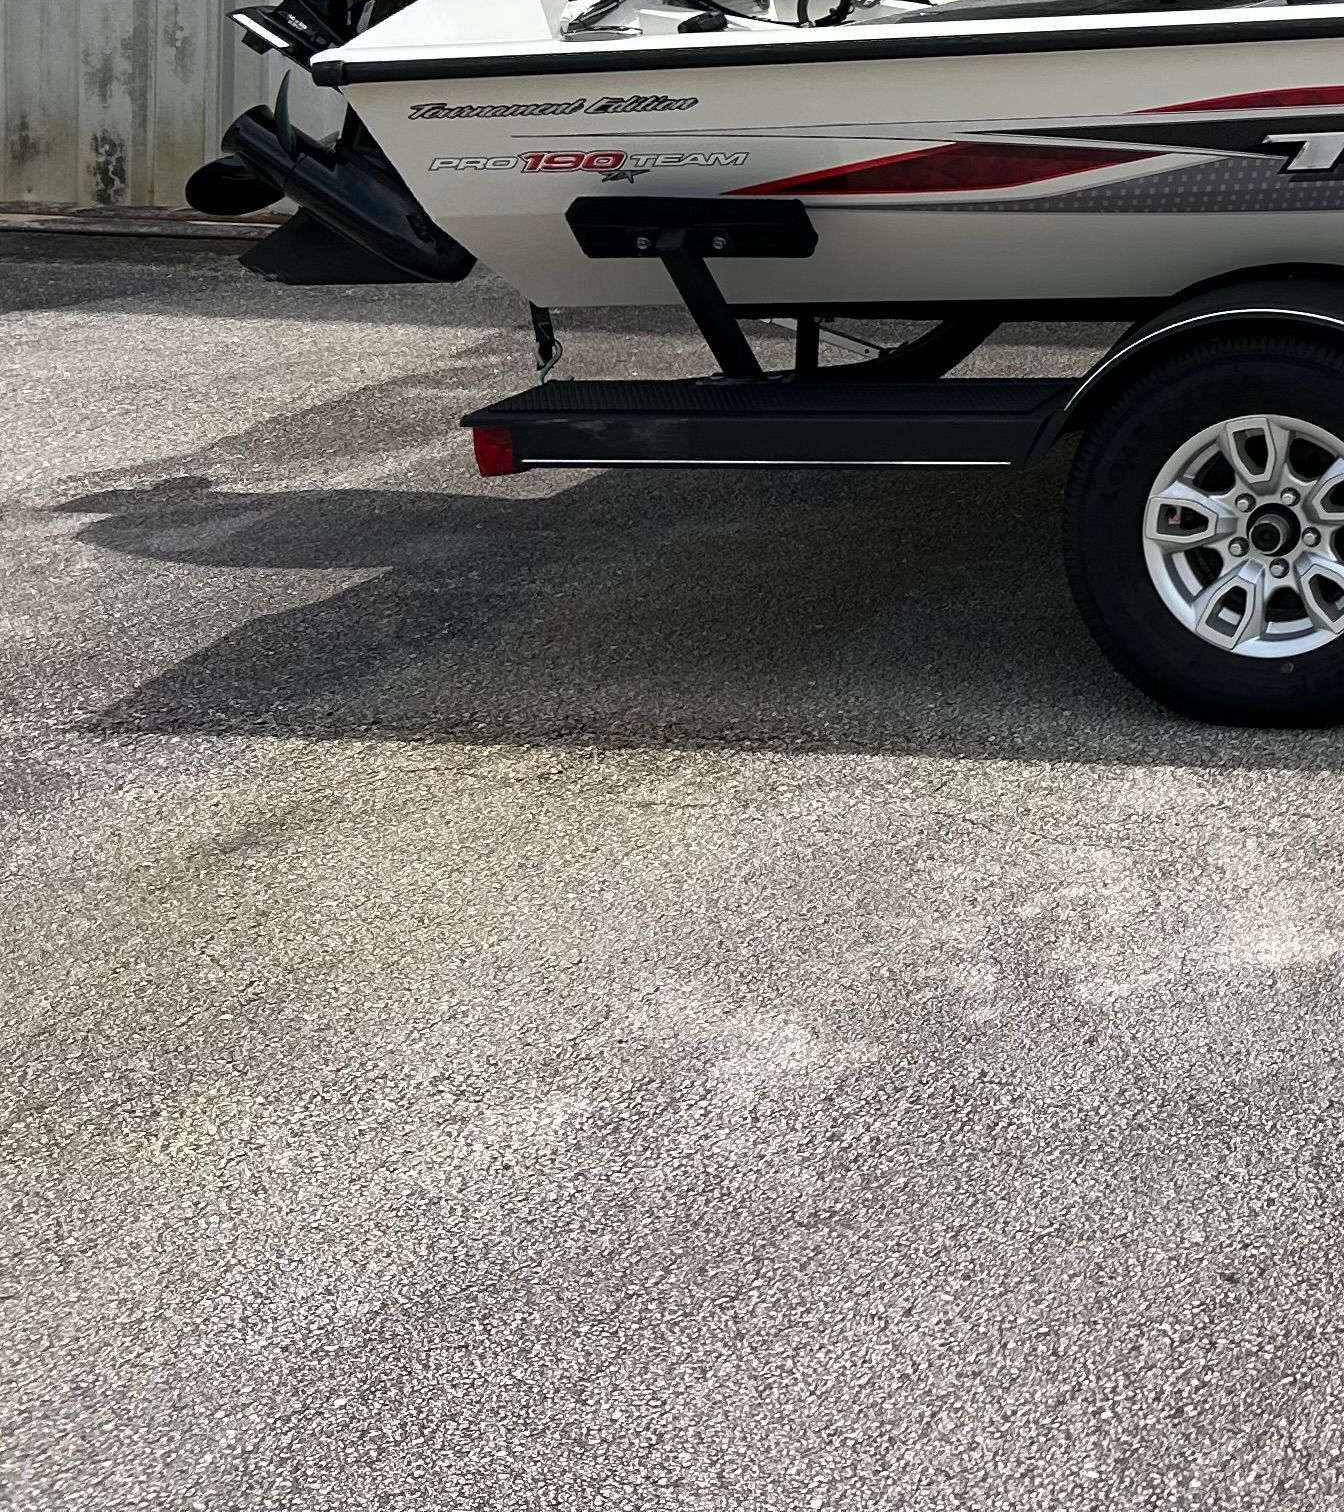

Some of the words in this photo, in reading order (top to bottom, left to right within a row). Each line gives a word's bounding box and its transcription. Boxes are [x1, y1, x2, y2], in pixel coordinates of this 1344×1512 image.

[408, 98, 587, 120] Tournament
[584, 95, 699, 115] Edition
[428, 156, 519, 172] PRO
[516, 150, 628, 173] 190
[628, 152, 750, 167] TEAM
